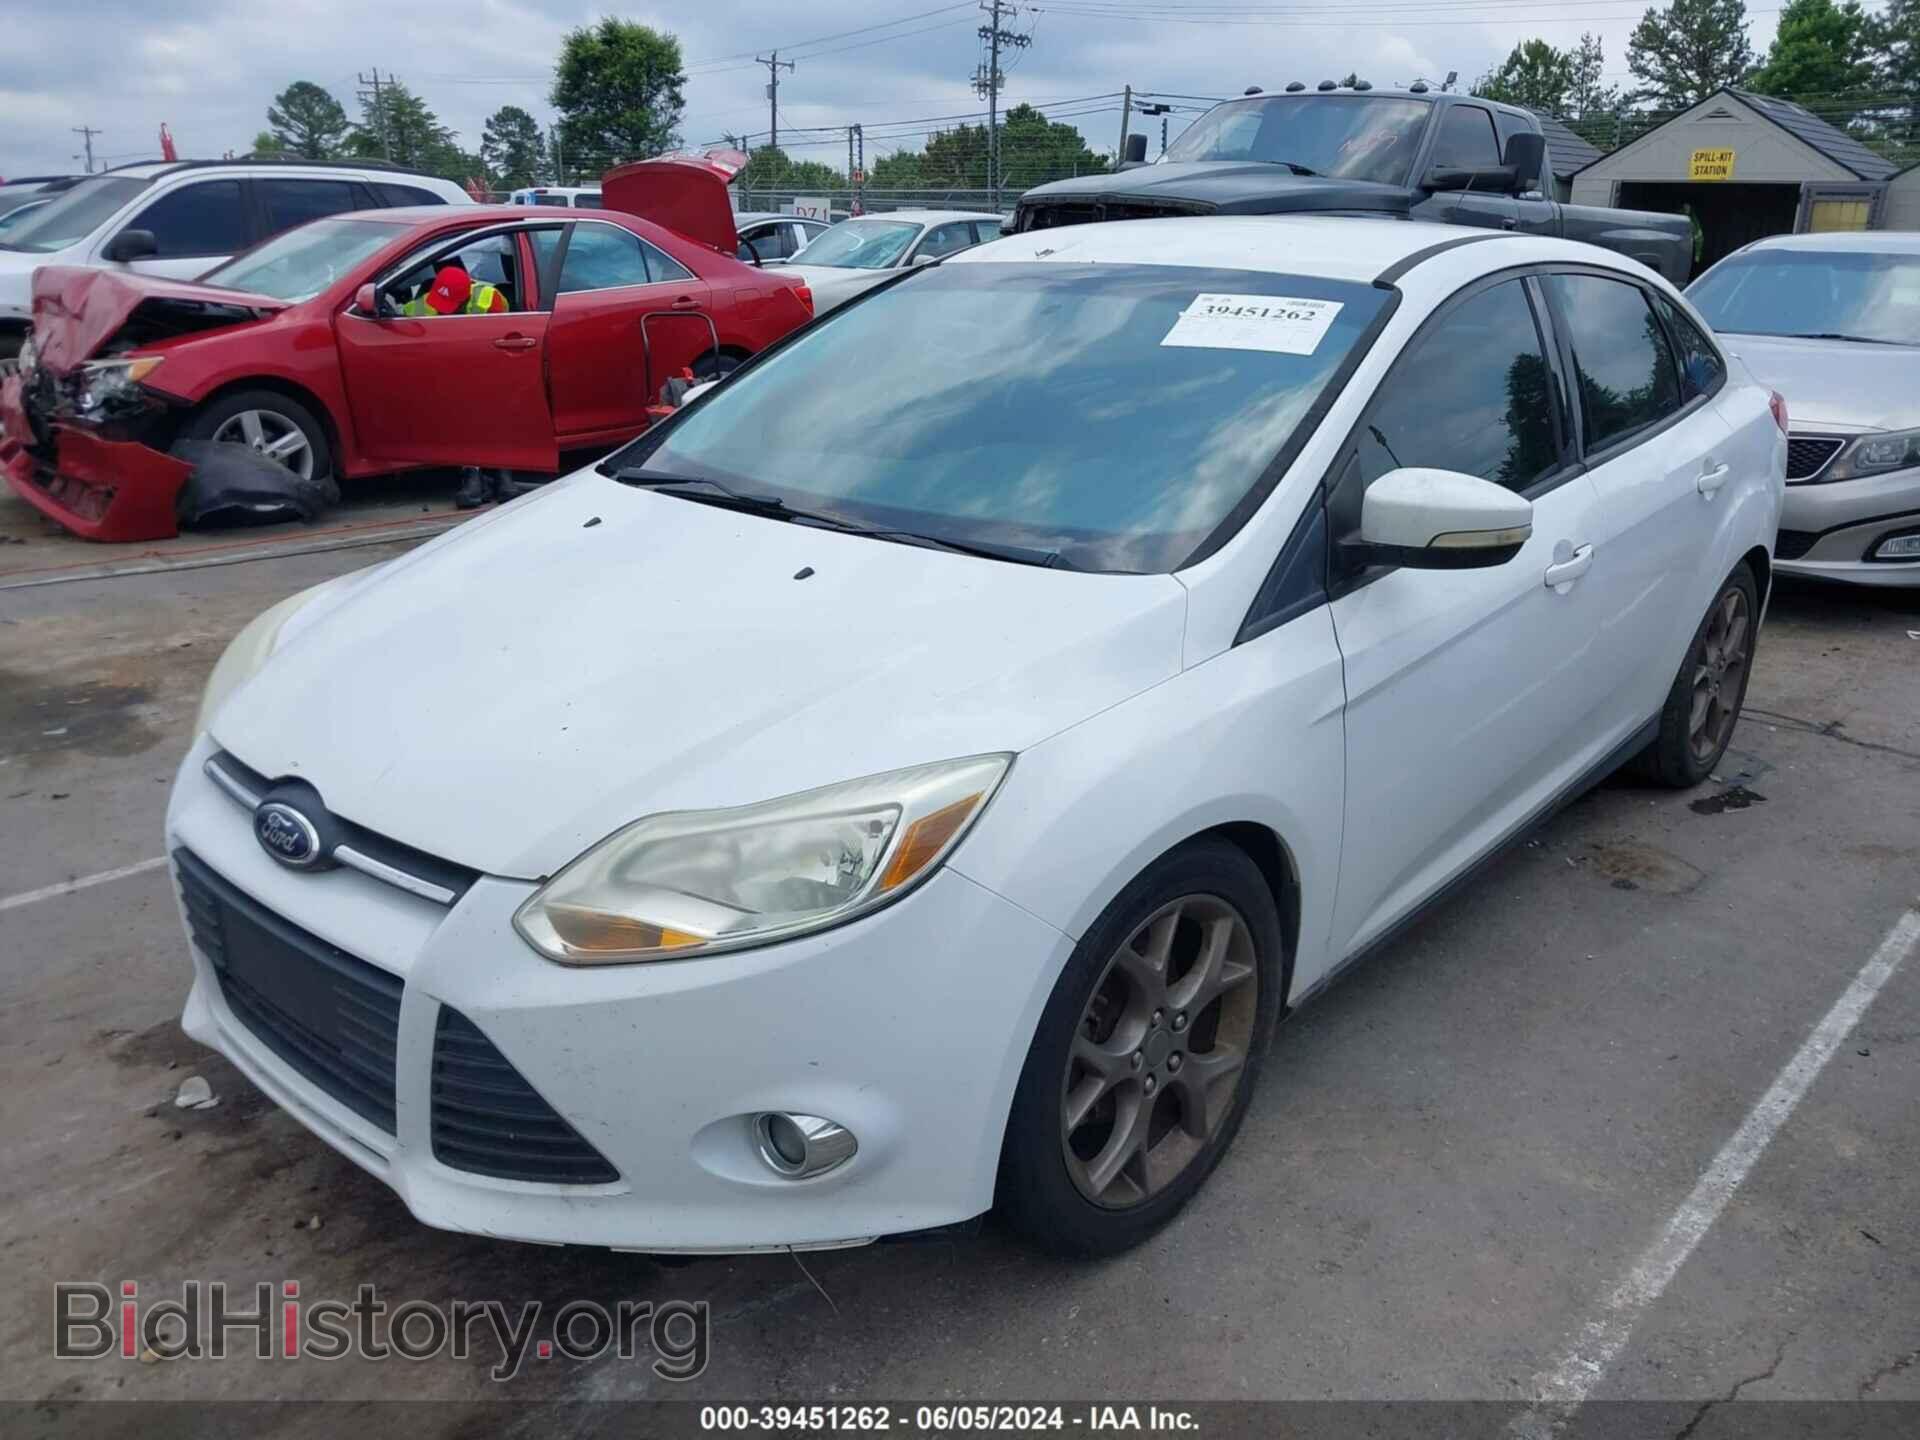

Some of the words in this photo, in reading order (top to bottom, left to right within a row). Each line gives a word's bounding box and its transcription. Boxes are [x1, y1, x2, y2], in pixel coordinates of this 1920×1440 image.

[1694, 152, 1733, 162] SPILL-KIT
[1694, 165, 1728, 175] STATION
[1203, 305, 1316, 321] 39451262
[262, 812, 299, 852] Ford
